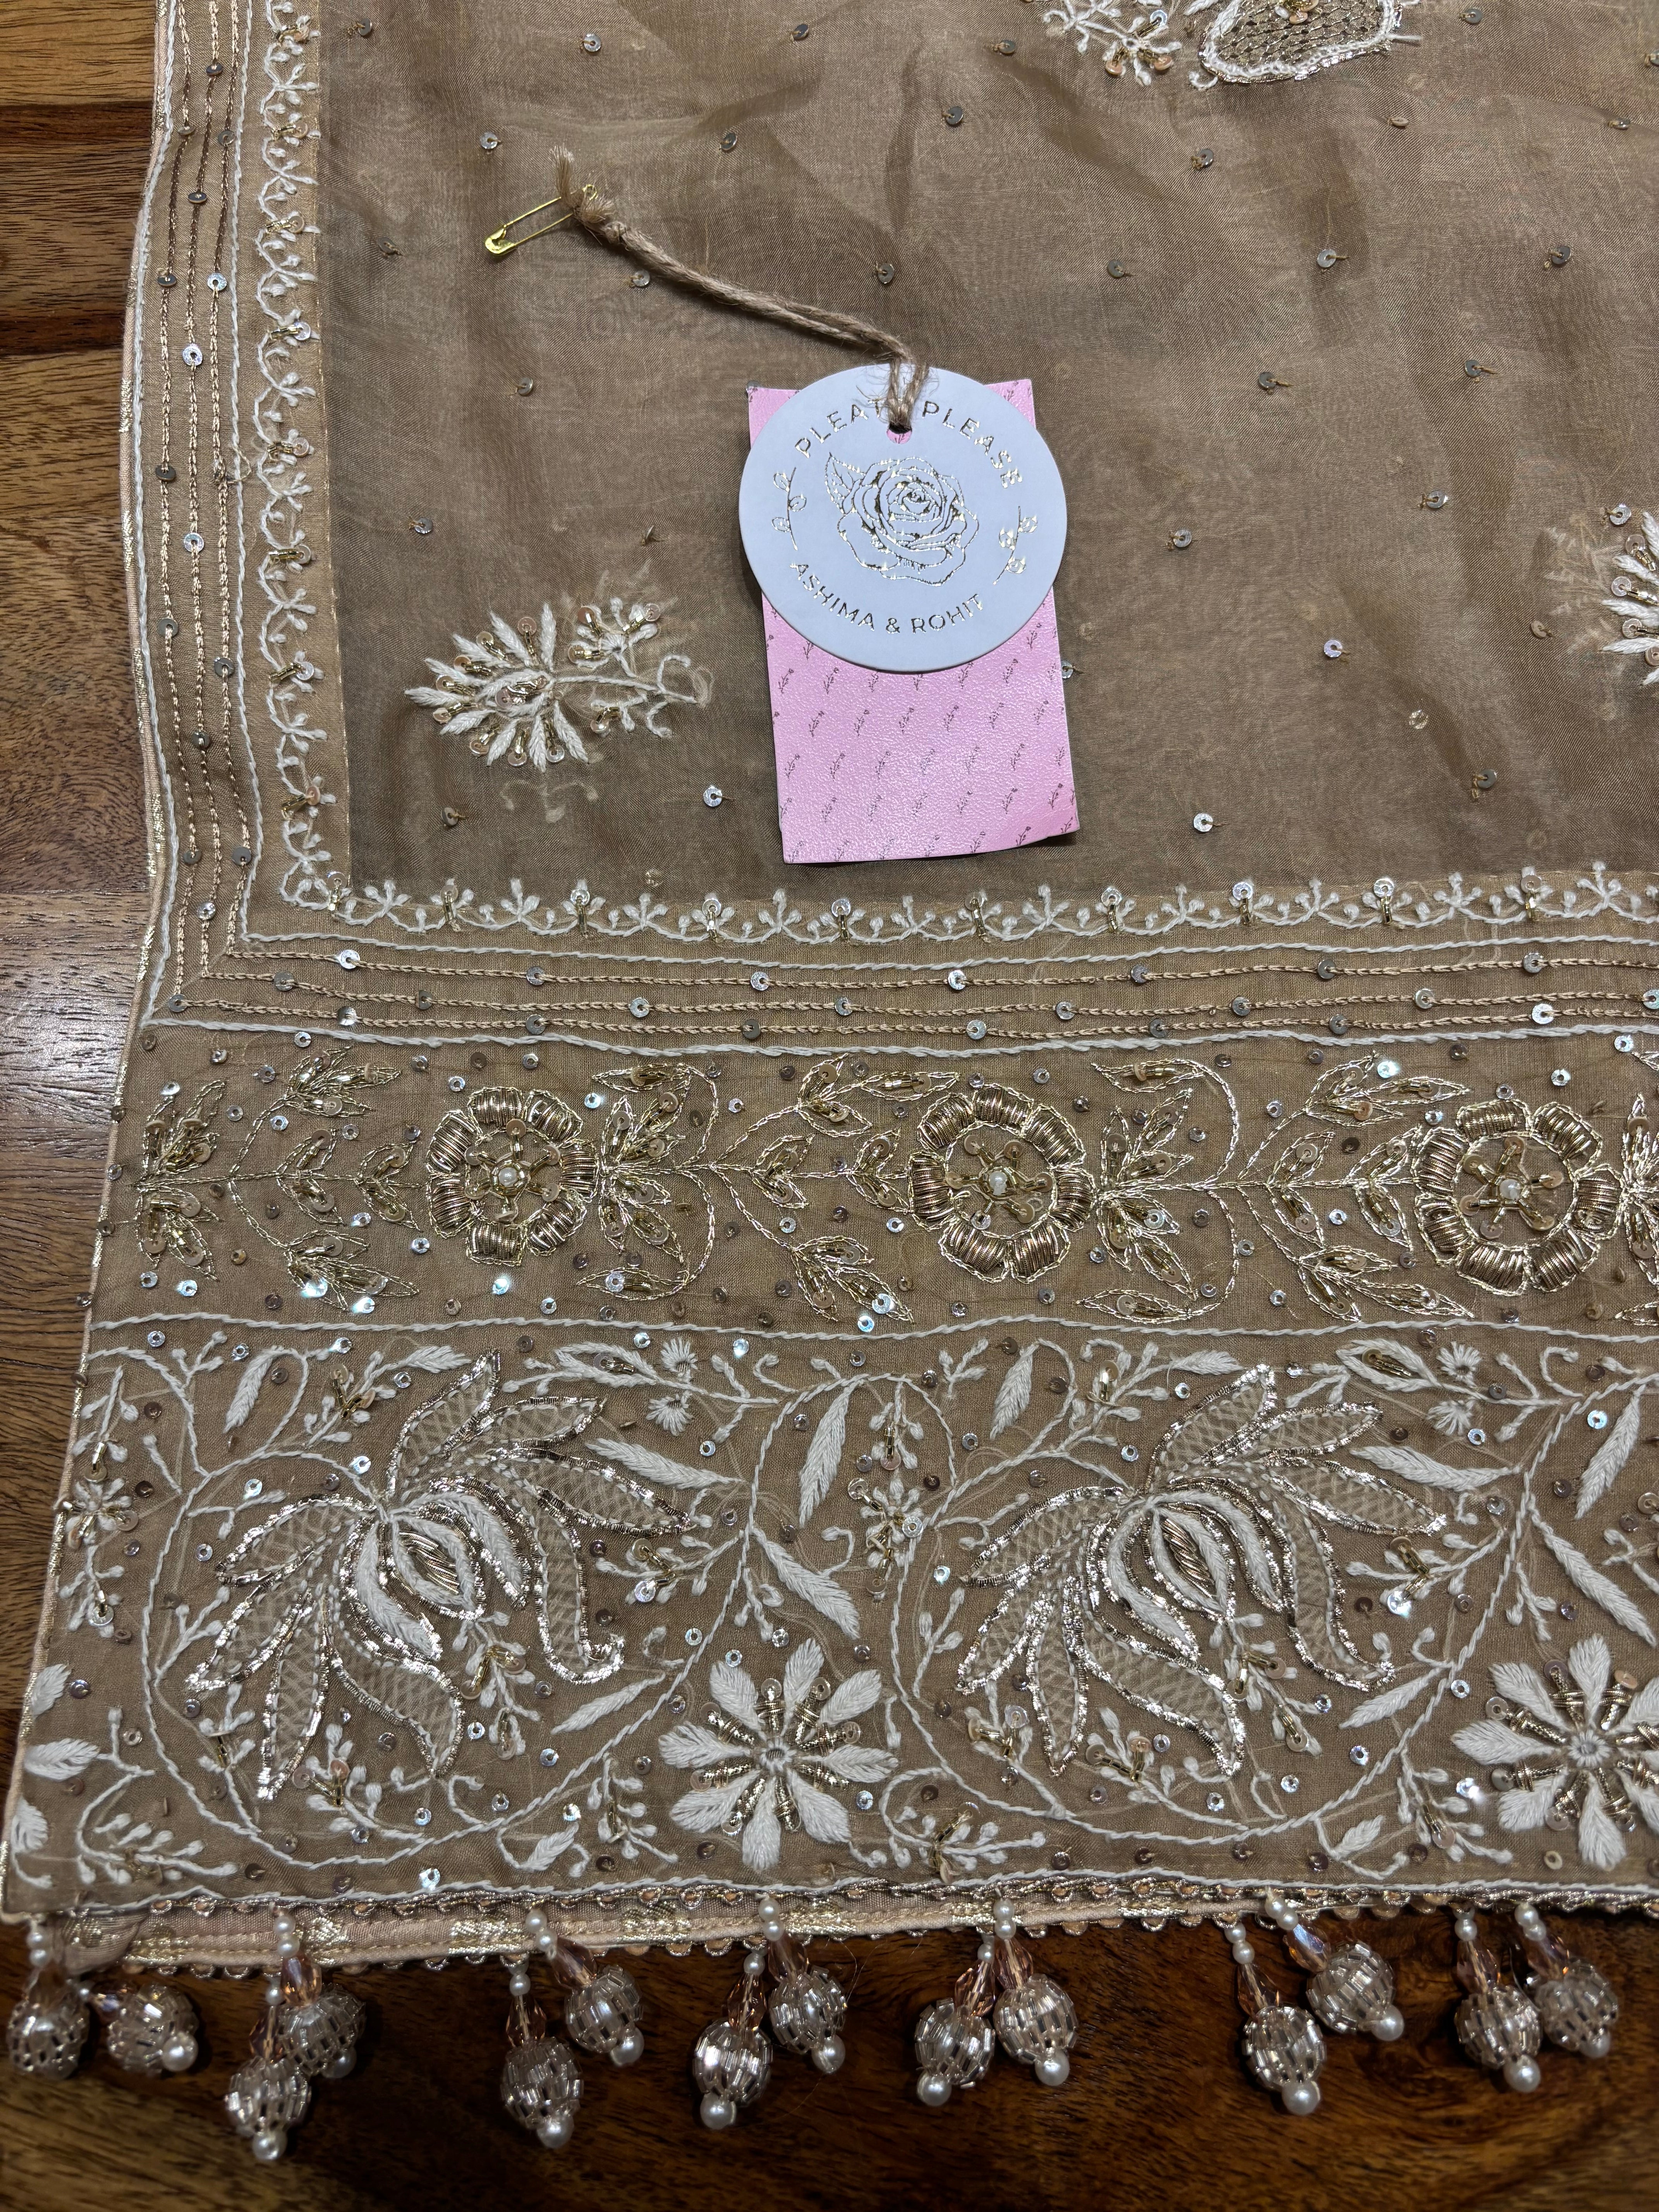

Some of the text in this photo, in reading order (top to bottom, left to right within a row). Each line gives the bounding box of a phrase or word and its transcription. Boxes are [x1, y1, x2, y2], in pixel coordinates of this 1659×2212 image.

[795, 398, 1022, 488] PLEAT PLEASE
[790, 563, 983, 634] ASHIMA & ROHIT
